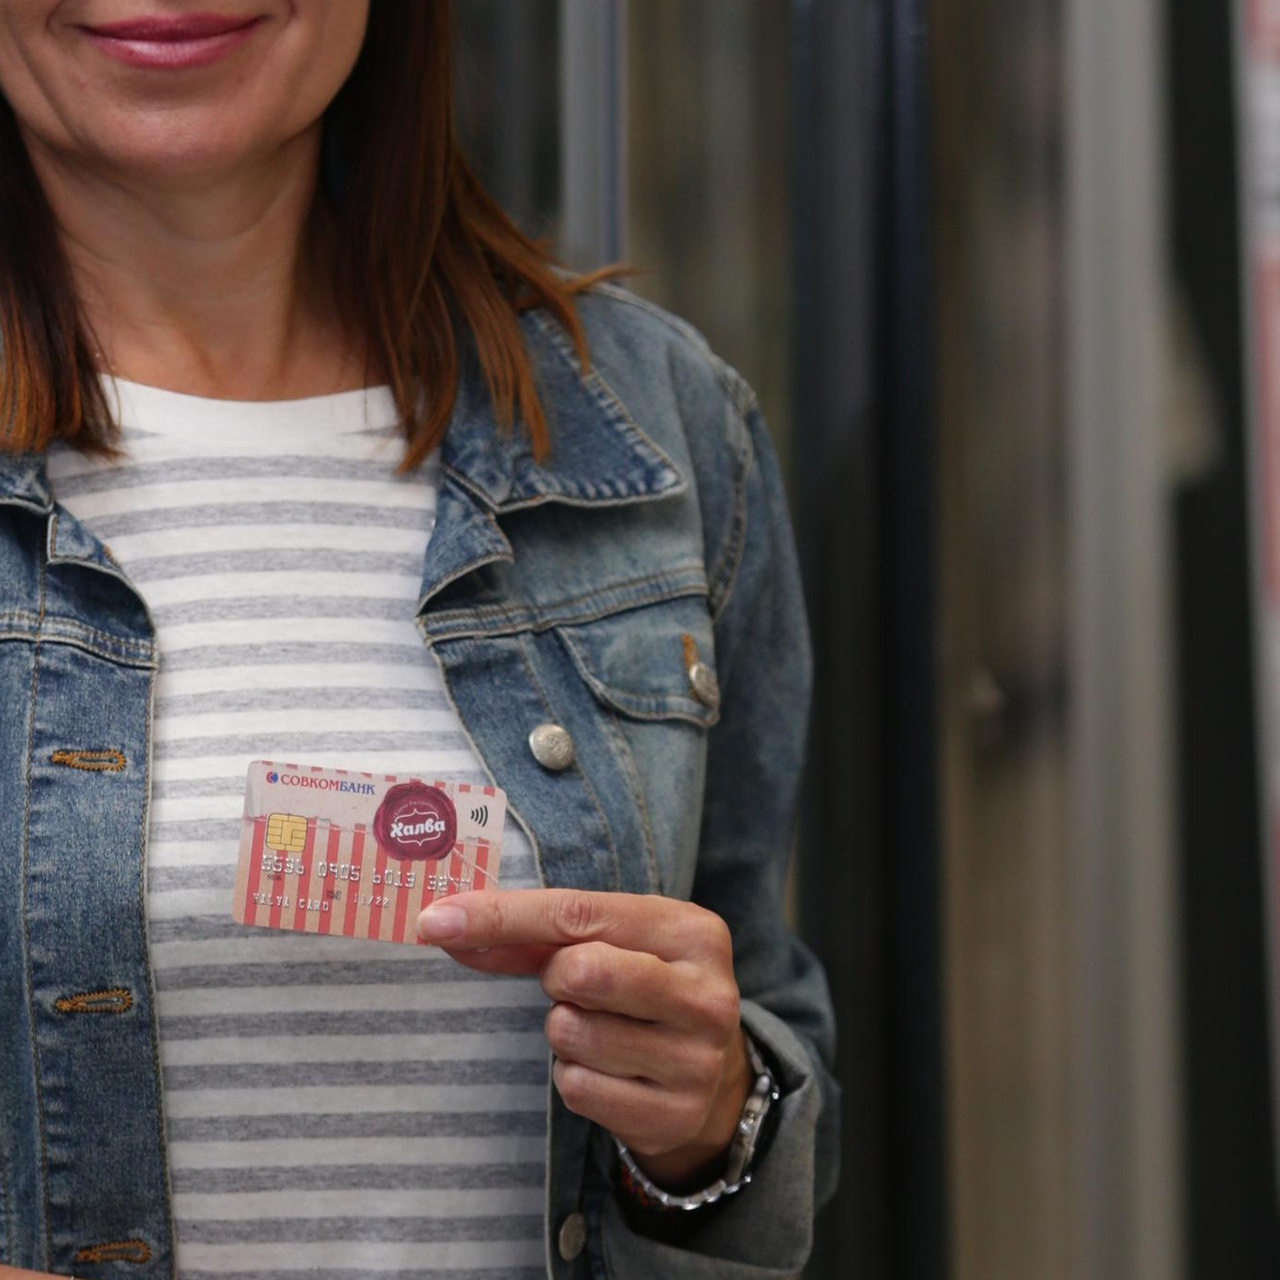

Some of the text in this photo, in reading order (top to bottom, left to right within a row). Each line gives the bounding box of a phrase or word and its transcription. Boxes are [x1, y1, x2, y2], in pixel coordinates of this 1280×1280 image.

[281, 774, 375, 795] СОВКОМБАНК
[390, 818, 446, 838] Халва
[261, 854, 305, 875] 5536
[317, 861, 361, 882] 0905
[372, 867, 415, 889] 6013
[298, 897, 330, 912] CARD
